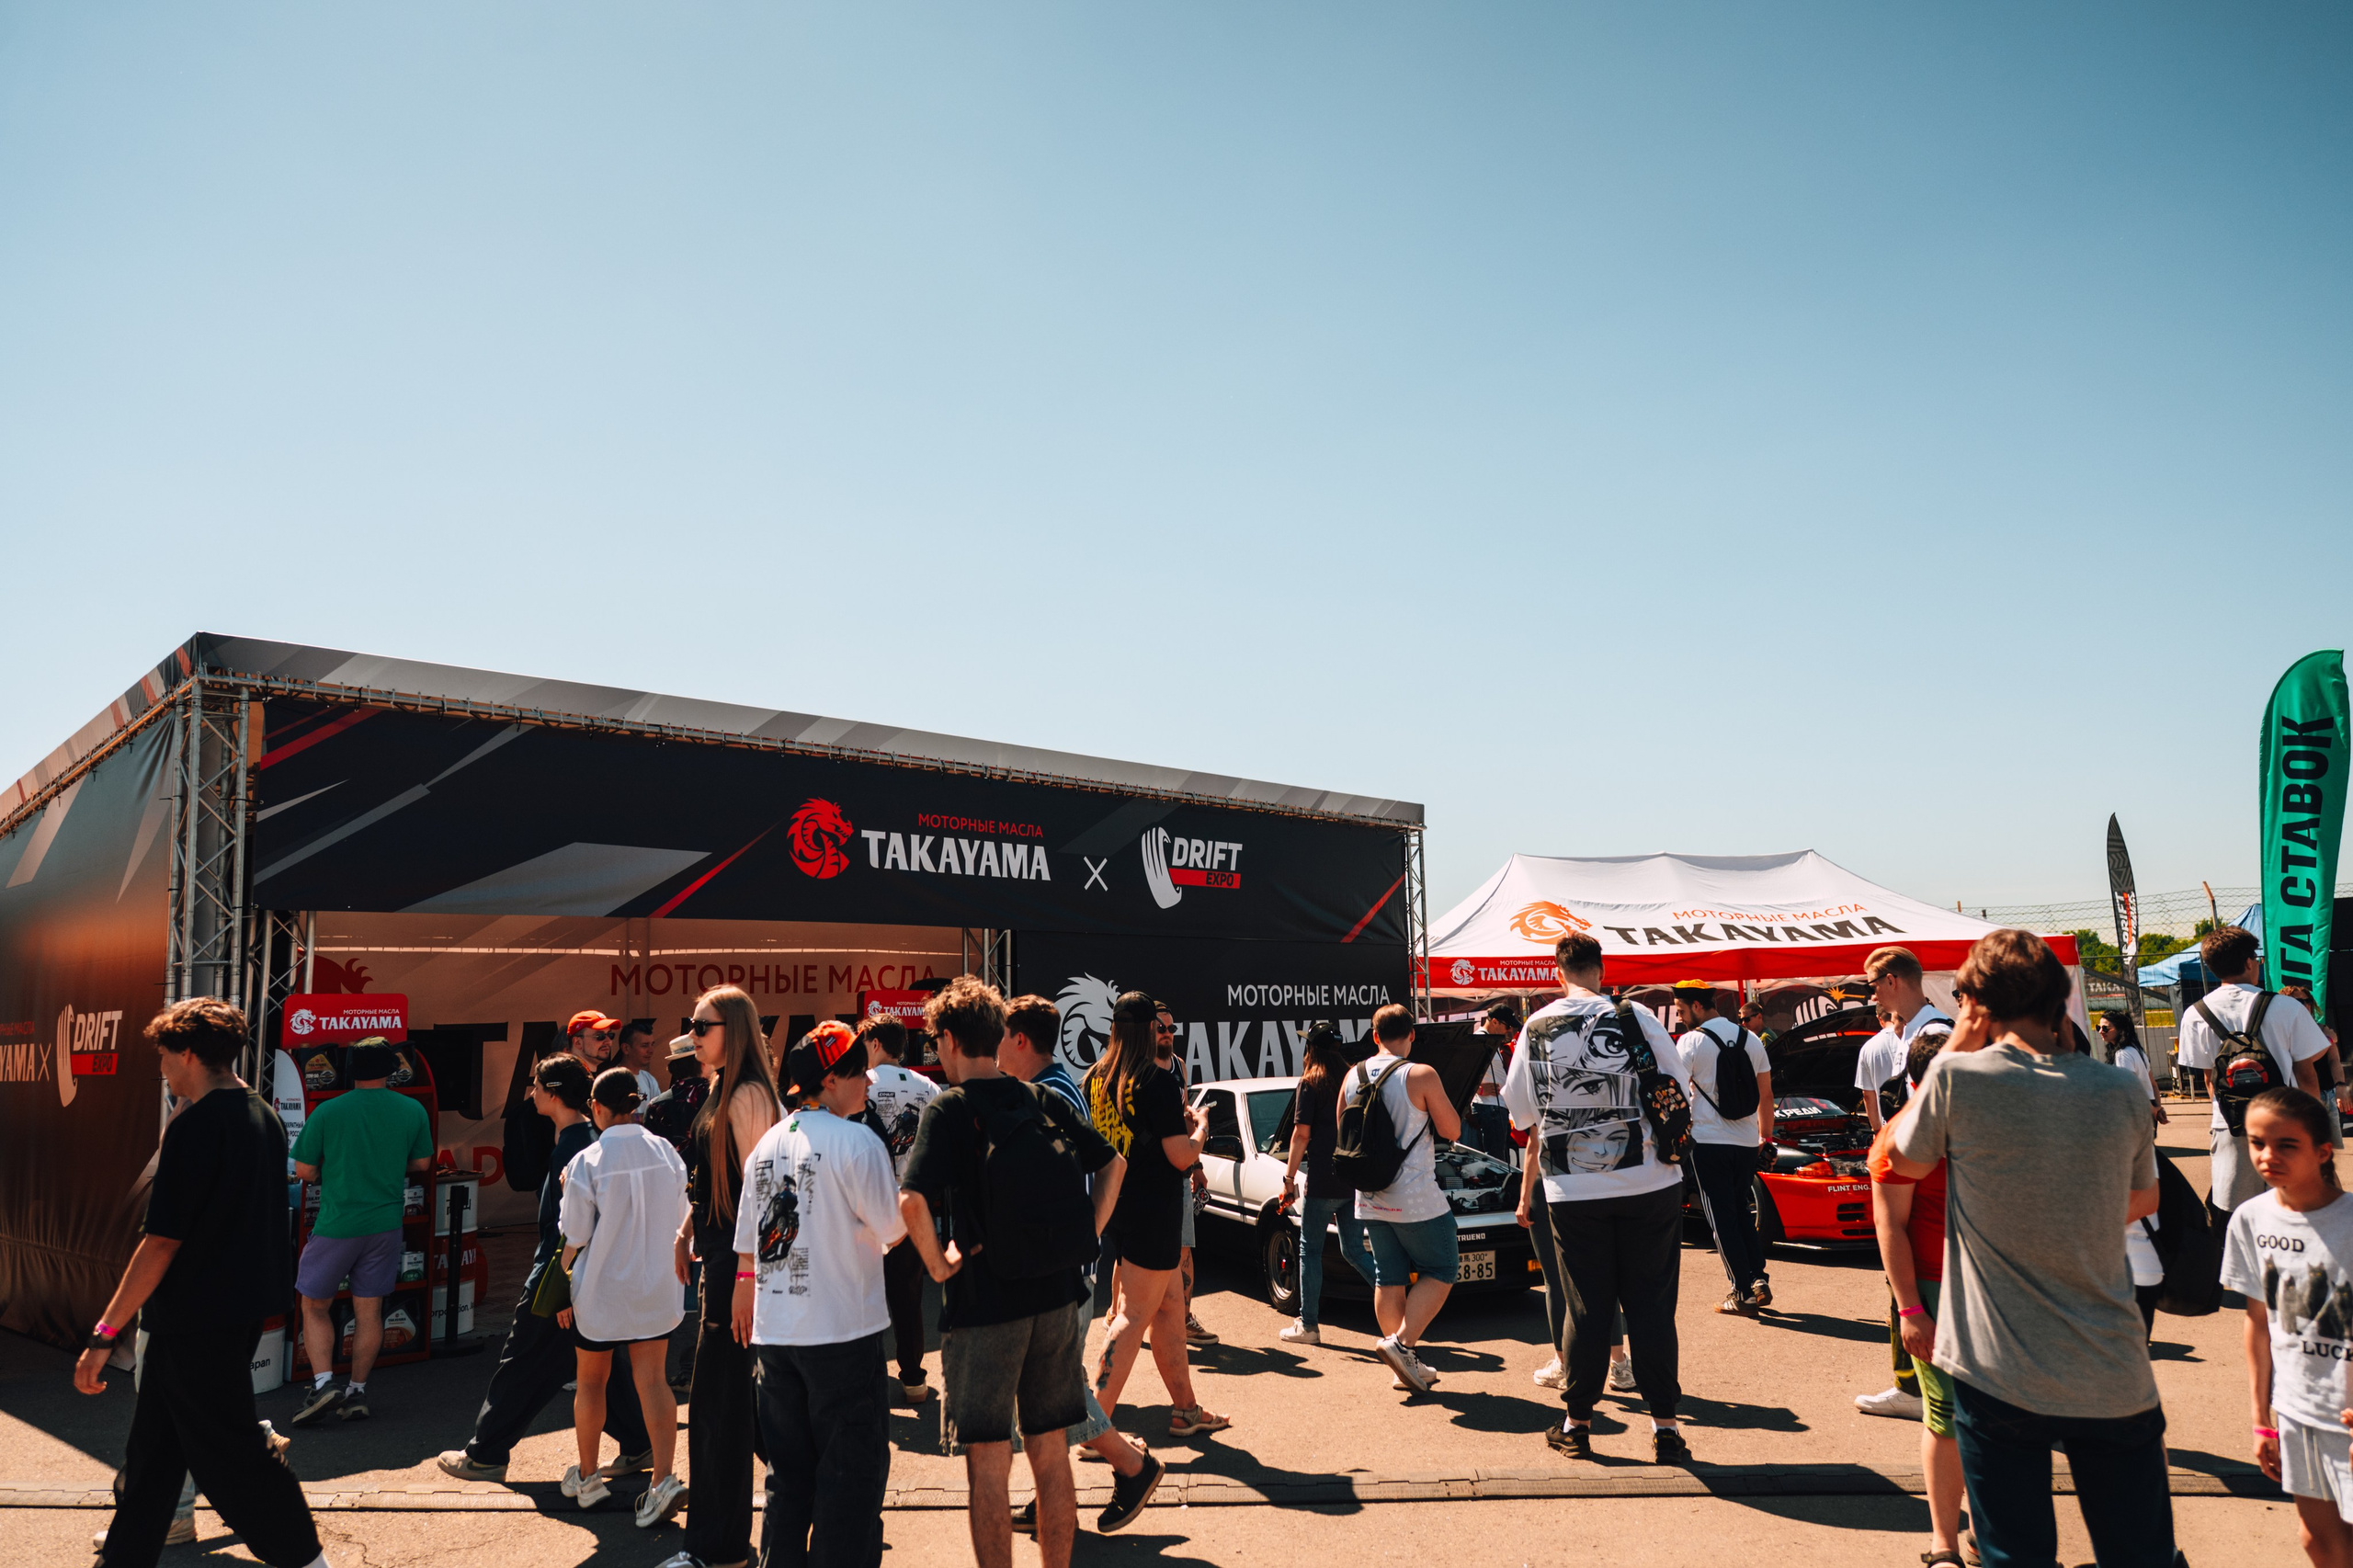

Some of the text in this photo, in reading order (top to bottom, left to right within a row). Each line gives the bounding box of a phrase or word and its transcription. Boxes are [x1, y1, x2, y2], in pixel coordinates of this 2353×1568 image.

[2280, 715, 2335, 908] СТАВОК
[918, 813, 1043, 837] МОТОРНЫЕ МАСЛА
[861, 829, 1051, 881] TAKAYAMA
[1172, 837, 1243, 870] DRIFT
[1206, 872, 1233, 887] EXPO
[1672, 903, 1868, 923] МОТОРНЫЕ МАСЛА
[1603, 916, 1909, 946] TAKAYAMA
[610, 964, 935, 996] МОТОРНЫЕ МАСЛА
[1478, 967, 1559, 982] TAKAYAMA
[1227, 984, 1391, 1006] МОТОРНЫЕ МАСЛА
[883, 1006, 928, 1017] TAKAYAM
[74, 1010, 123, 1051] DRIFT
[319, 1016, 403, 1030] TAKAYAMA
[93, 1055, 113, 1073] EXPO
[1827, 1185, 1850, 1193] FLINT
[1457, 1233, 1486, 1242] TRUENO
[2257, 1234, 2305, 1253] GOOD
[1472, 1253, 1484, 1262] 300
[250, 1358, 271, 1370] apan
